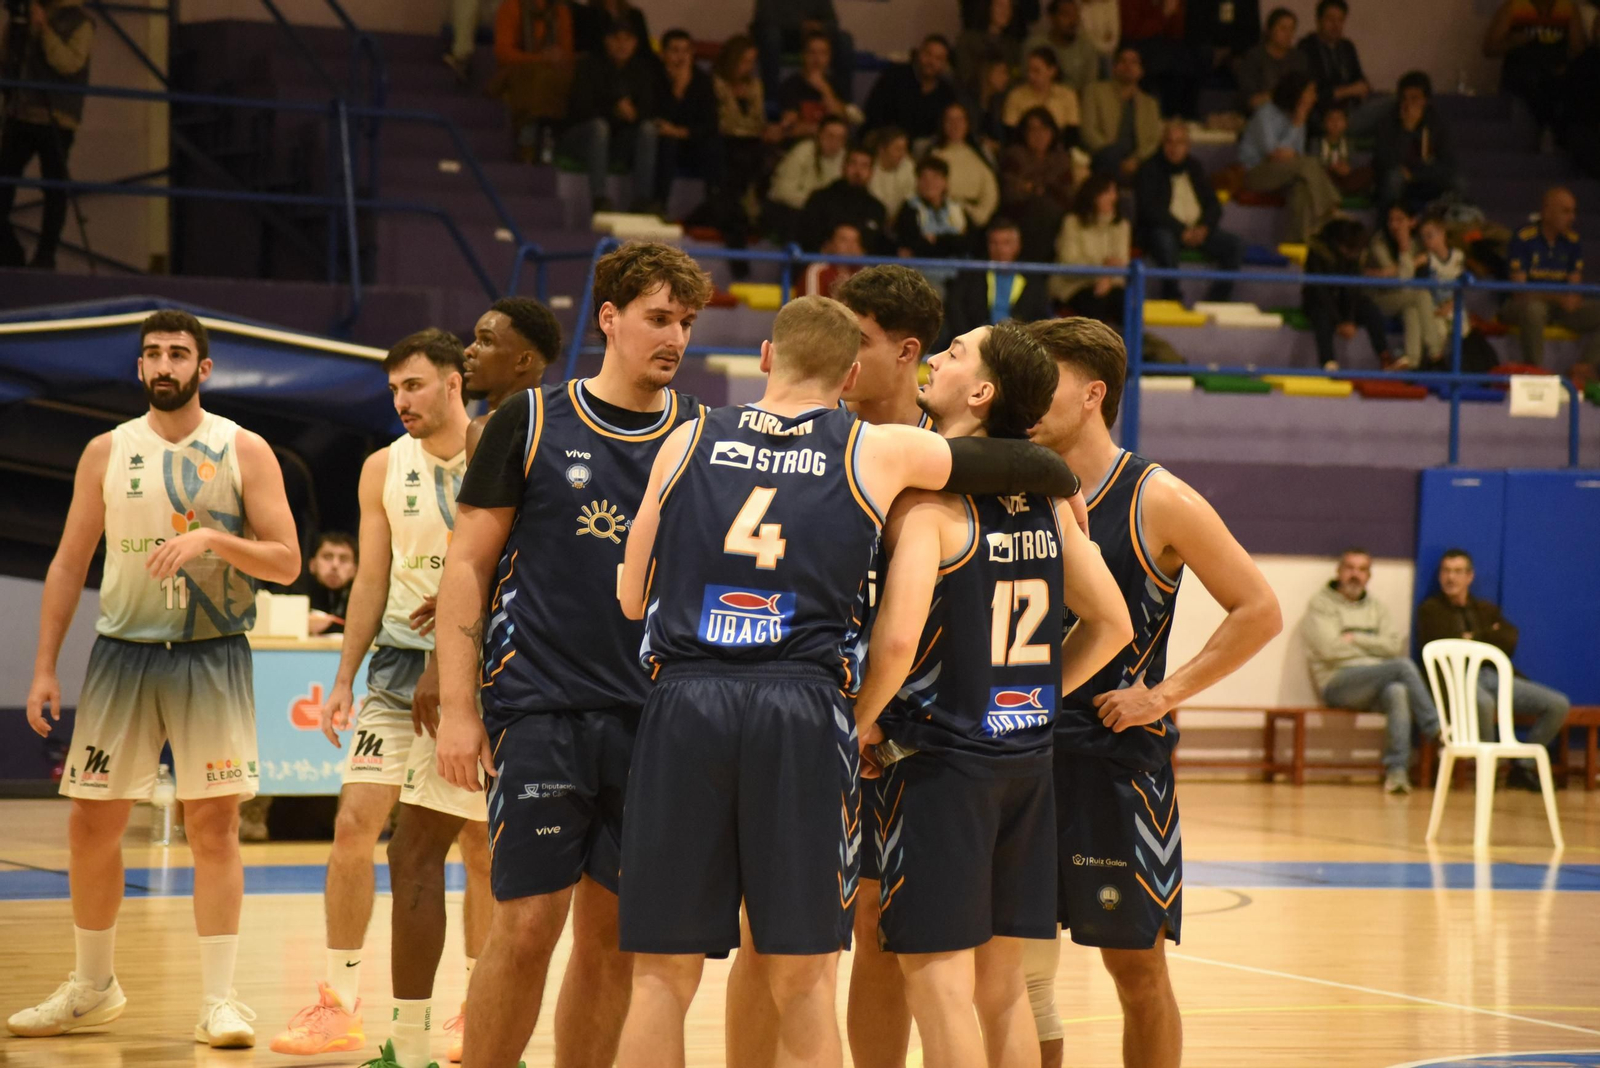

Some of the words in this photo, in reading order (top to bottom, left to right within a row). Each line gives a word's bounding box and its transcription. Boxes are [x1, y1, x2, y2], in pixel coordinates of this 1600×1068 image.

[565, 449, 591, 460] vive
[755, 448, 827, 477] STROG
[723, 485, 787, 570] 4
[121, 537, 166, 553] surs
[1013, 529, 1058, 561] TROG
[161, 576, 188, 610] 11
[706, 614, 783, 644] UBAGO
[990, 578, 1051, 667] 12
[206, 772, 218, 782] EL
[541, 783, 576, 791] Diputación
[535, 825, 561, 836] vive
[1089, 856, 1104, 865] Ruiz
[1105, 858, 1127, 867] Galán
